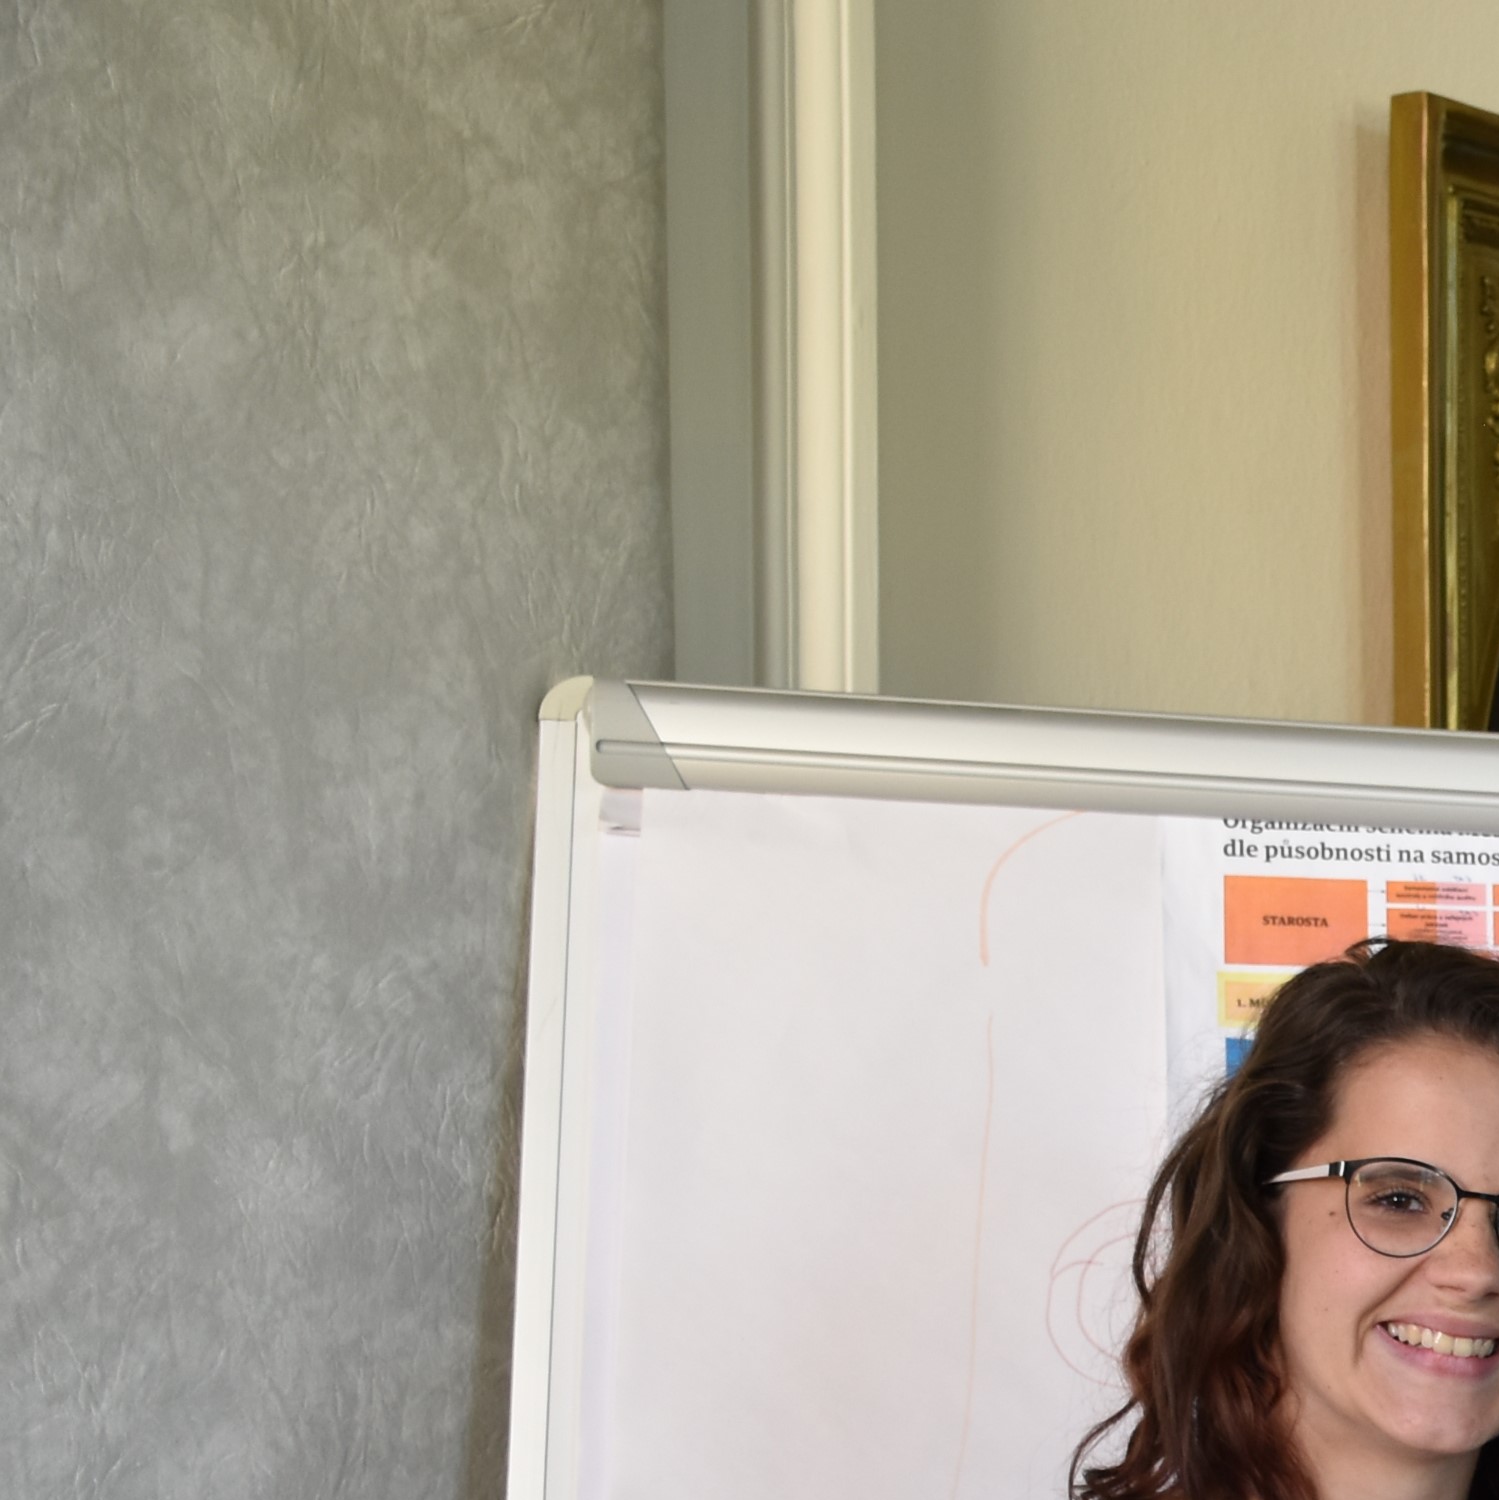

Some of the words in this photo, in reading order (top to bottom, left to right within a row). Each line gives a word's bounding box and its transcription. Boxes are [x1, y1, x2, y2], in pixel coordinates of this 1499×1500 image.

[1223, 838, 1258, 857] dle
[1264, 839, 1391, 863] působnosti
[1398, 850, 1425, 863] na
[1262, 914, 1329, 928] STAROSTA
